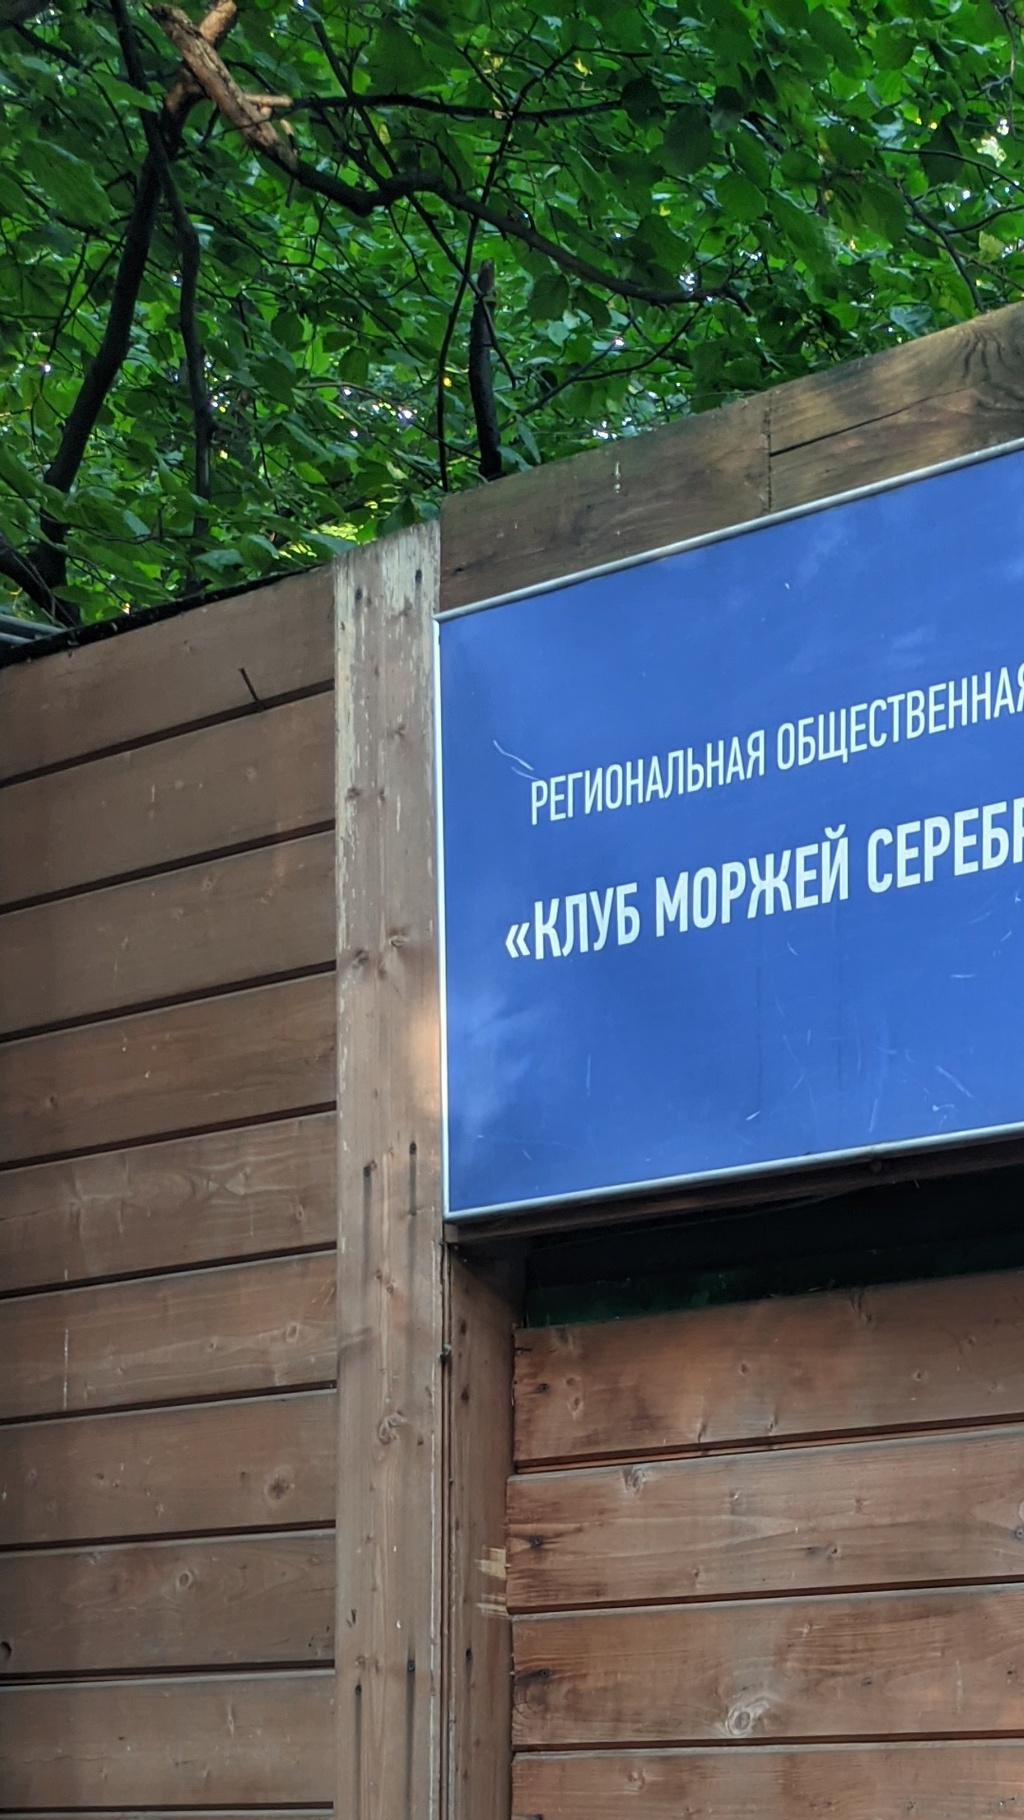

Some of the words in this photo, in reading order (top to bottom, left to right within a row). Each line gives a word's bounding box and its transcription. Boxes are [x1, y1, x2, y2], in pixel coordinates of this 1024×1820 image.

[531, 728, 766, 825] РЕГИОНАЛЬНАЯ
[504, 881, 641, 960] «КЛУБ
[655, 822, 849, 938] МОРЖЕЙ
